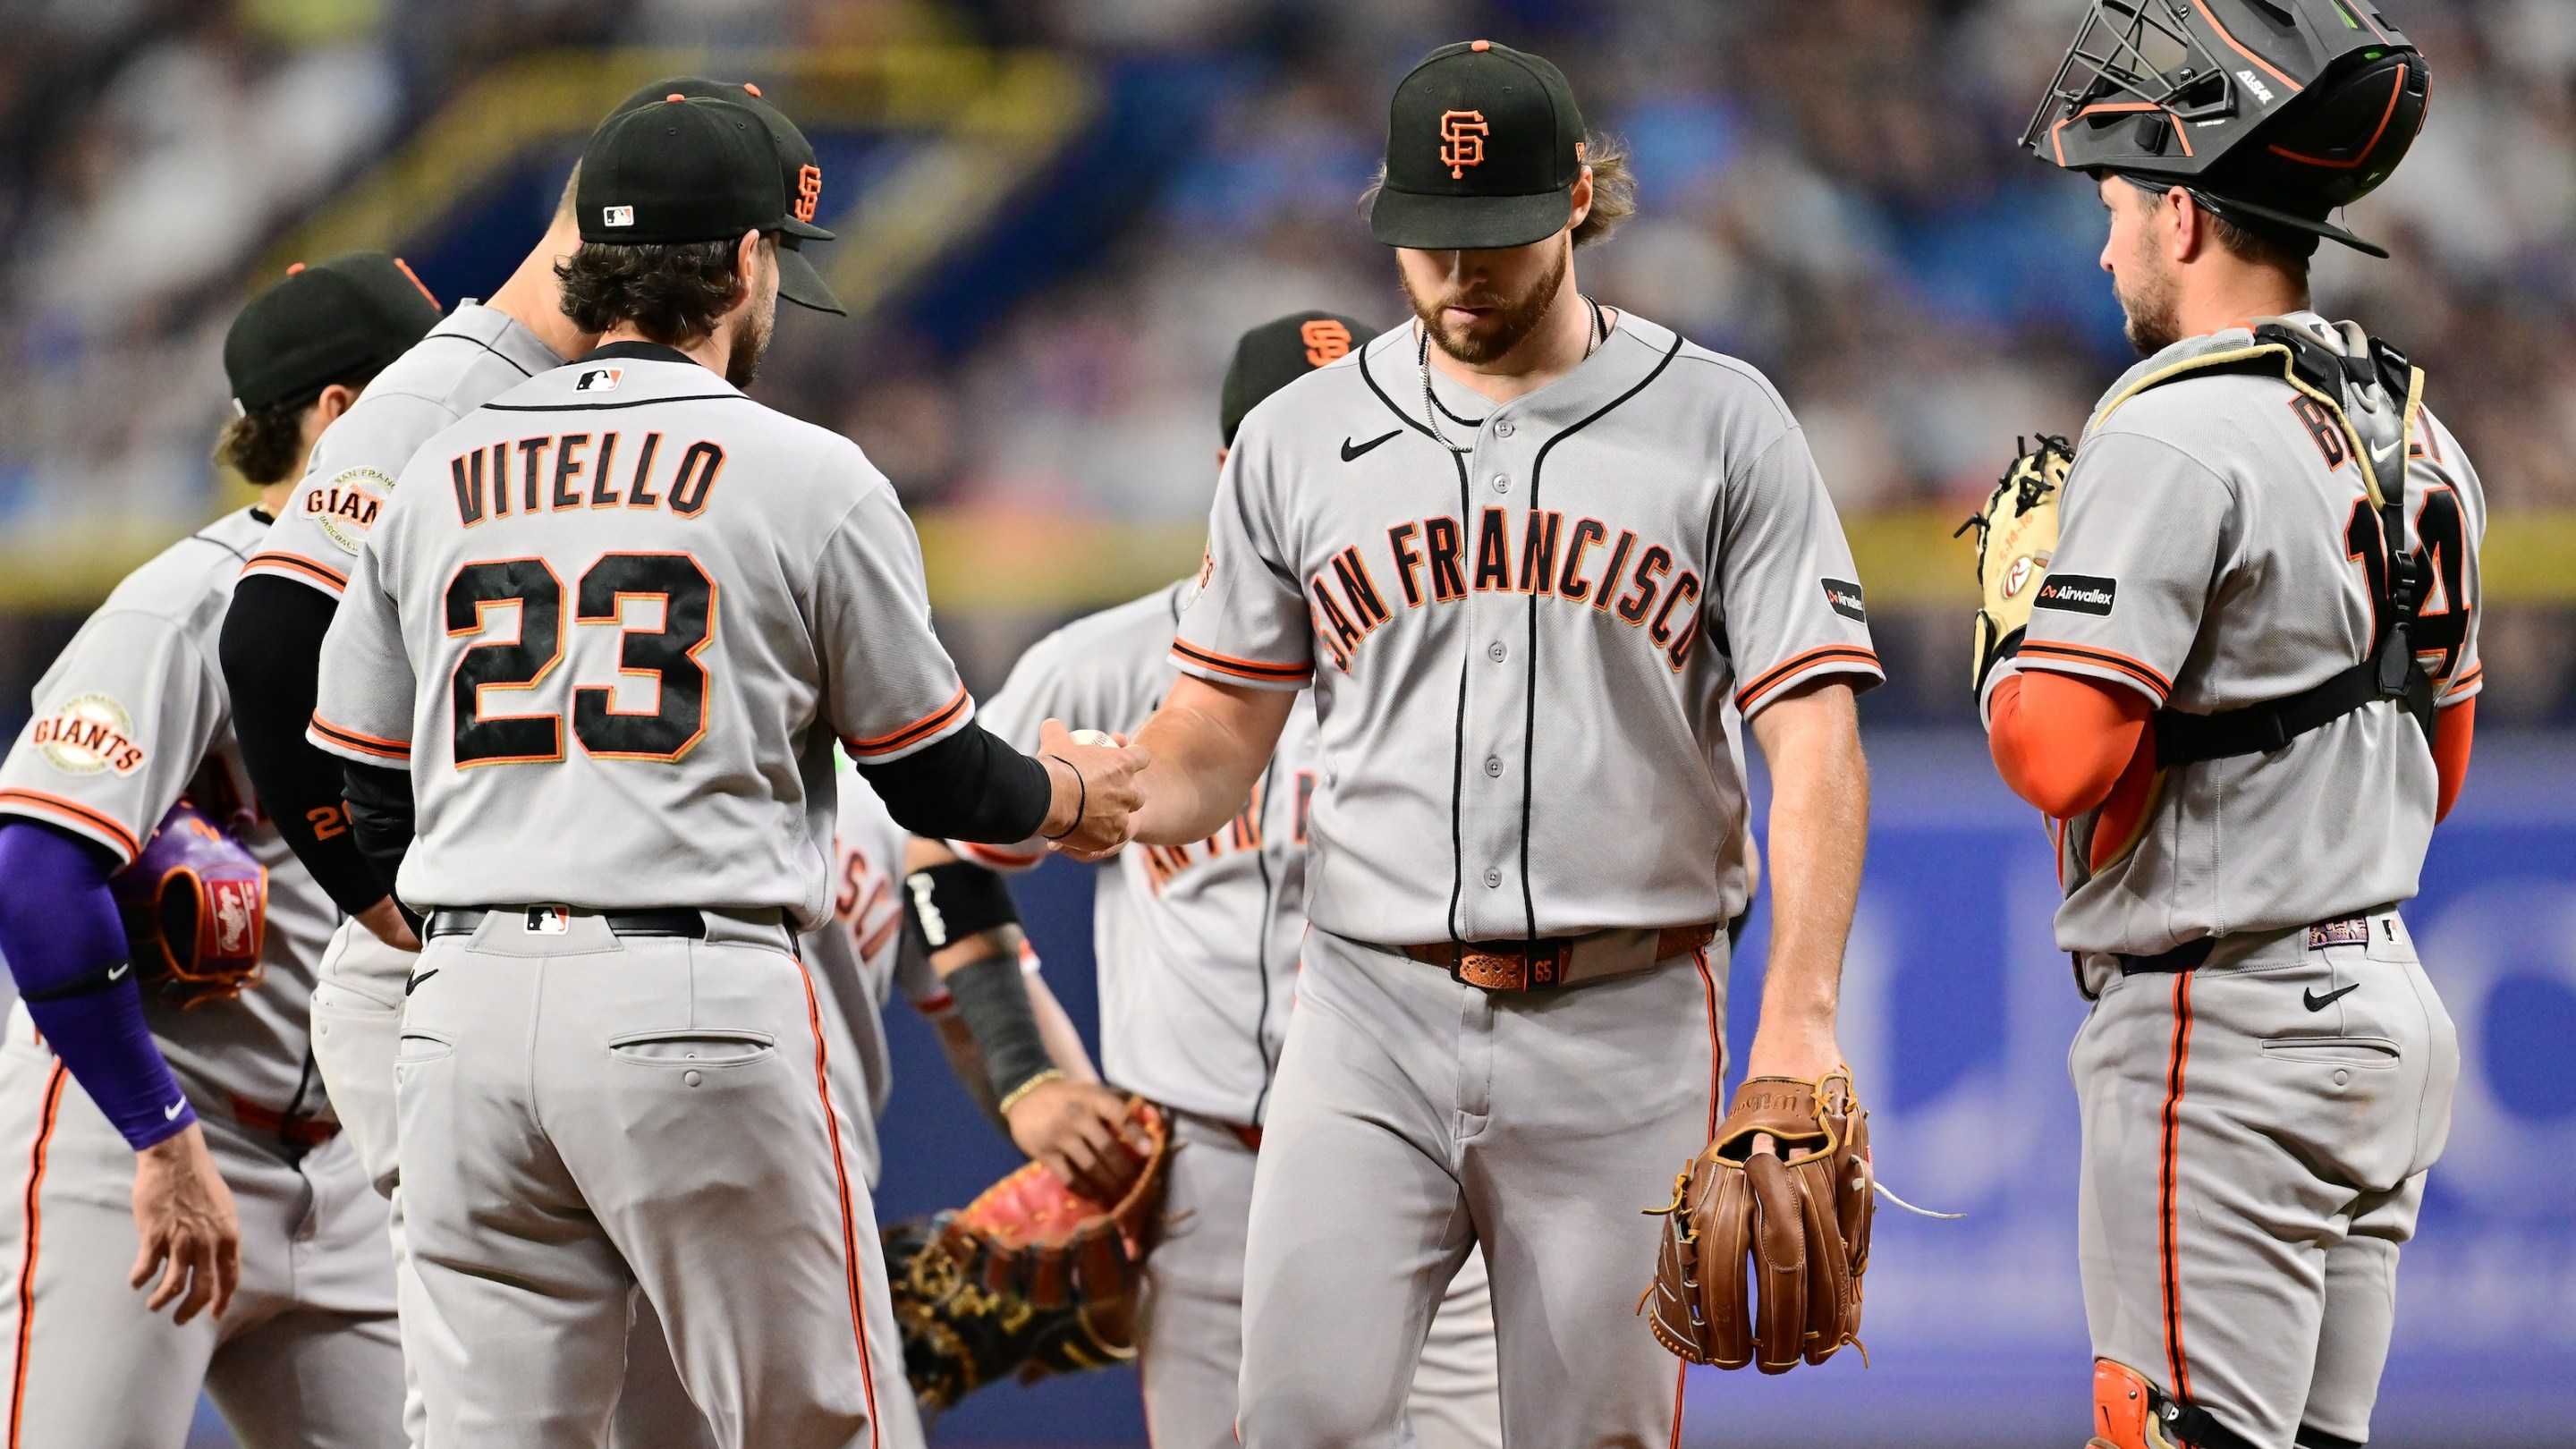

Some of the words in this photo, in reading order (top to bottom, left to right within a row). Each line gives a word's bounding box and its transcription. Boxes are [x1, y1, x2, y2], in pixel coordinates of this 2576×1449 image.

[1440, 109, 1489, 179] SF
[451, 431, 727, 529] VITELLO
[1309, 544, 1394, 675] SAN
[2055, 585, 2113, 606] Airwallex
[2343, 486, 2472, 684] 14
[444, 550, 721, 771] 23
[33, 716, 144, 772] GIANTS
[1535, 960, 1552, 982] 65
